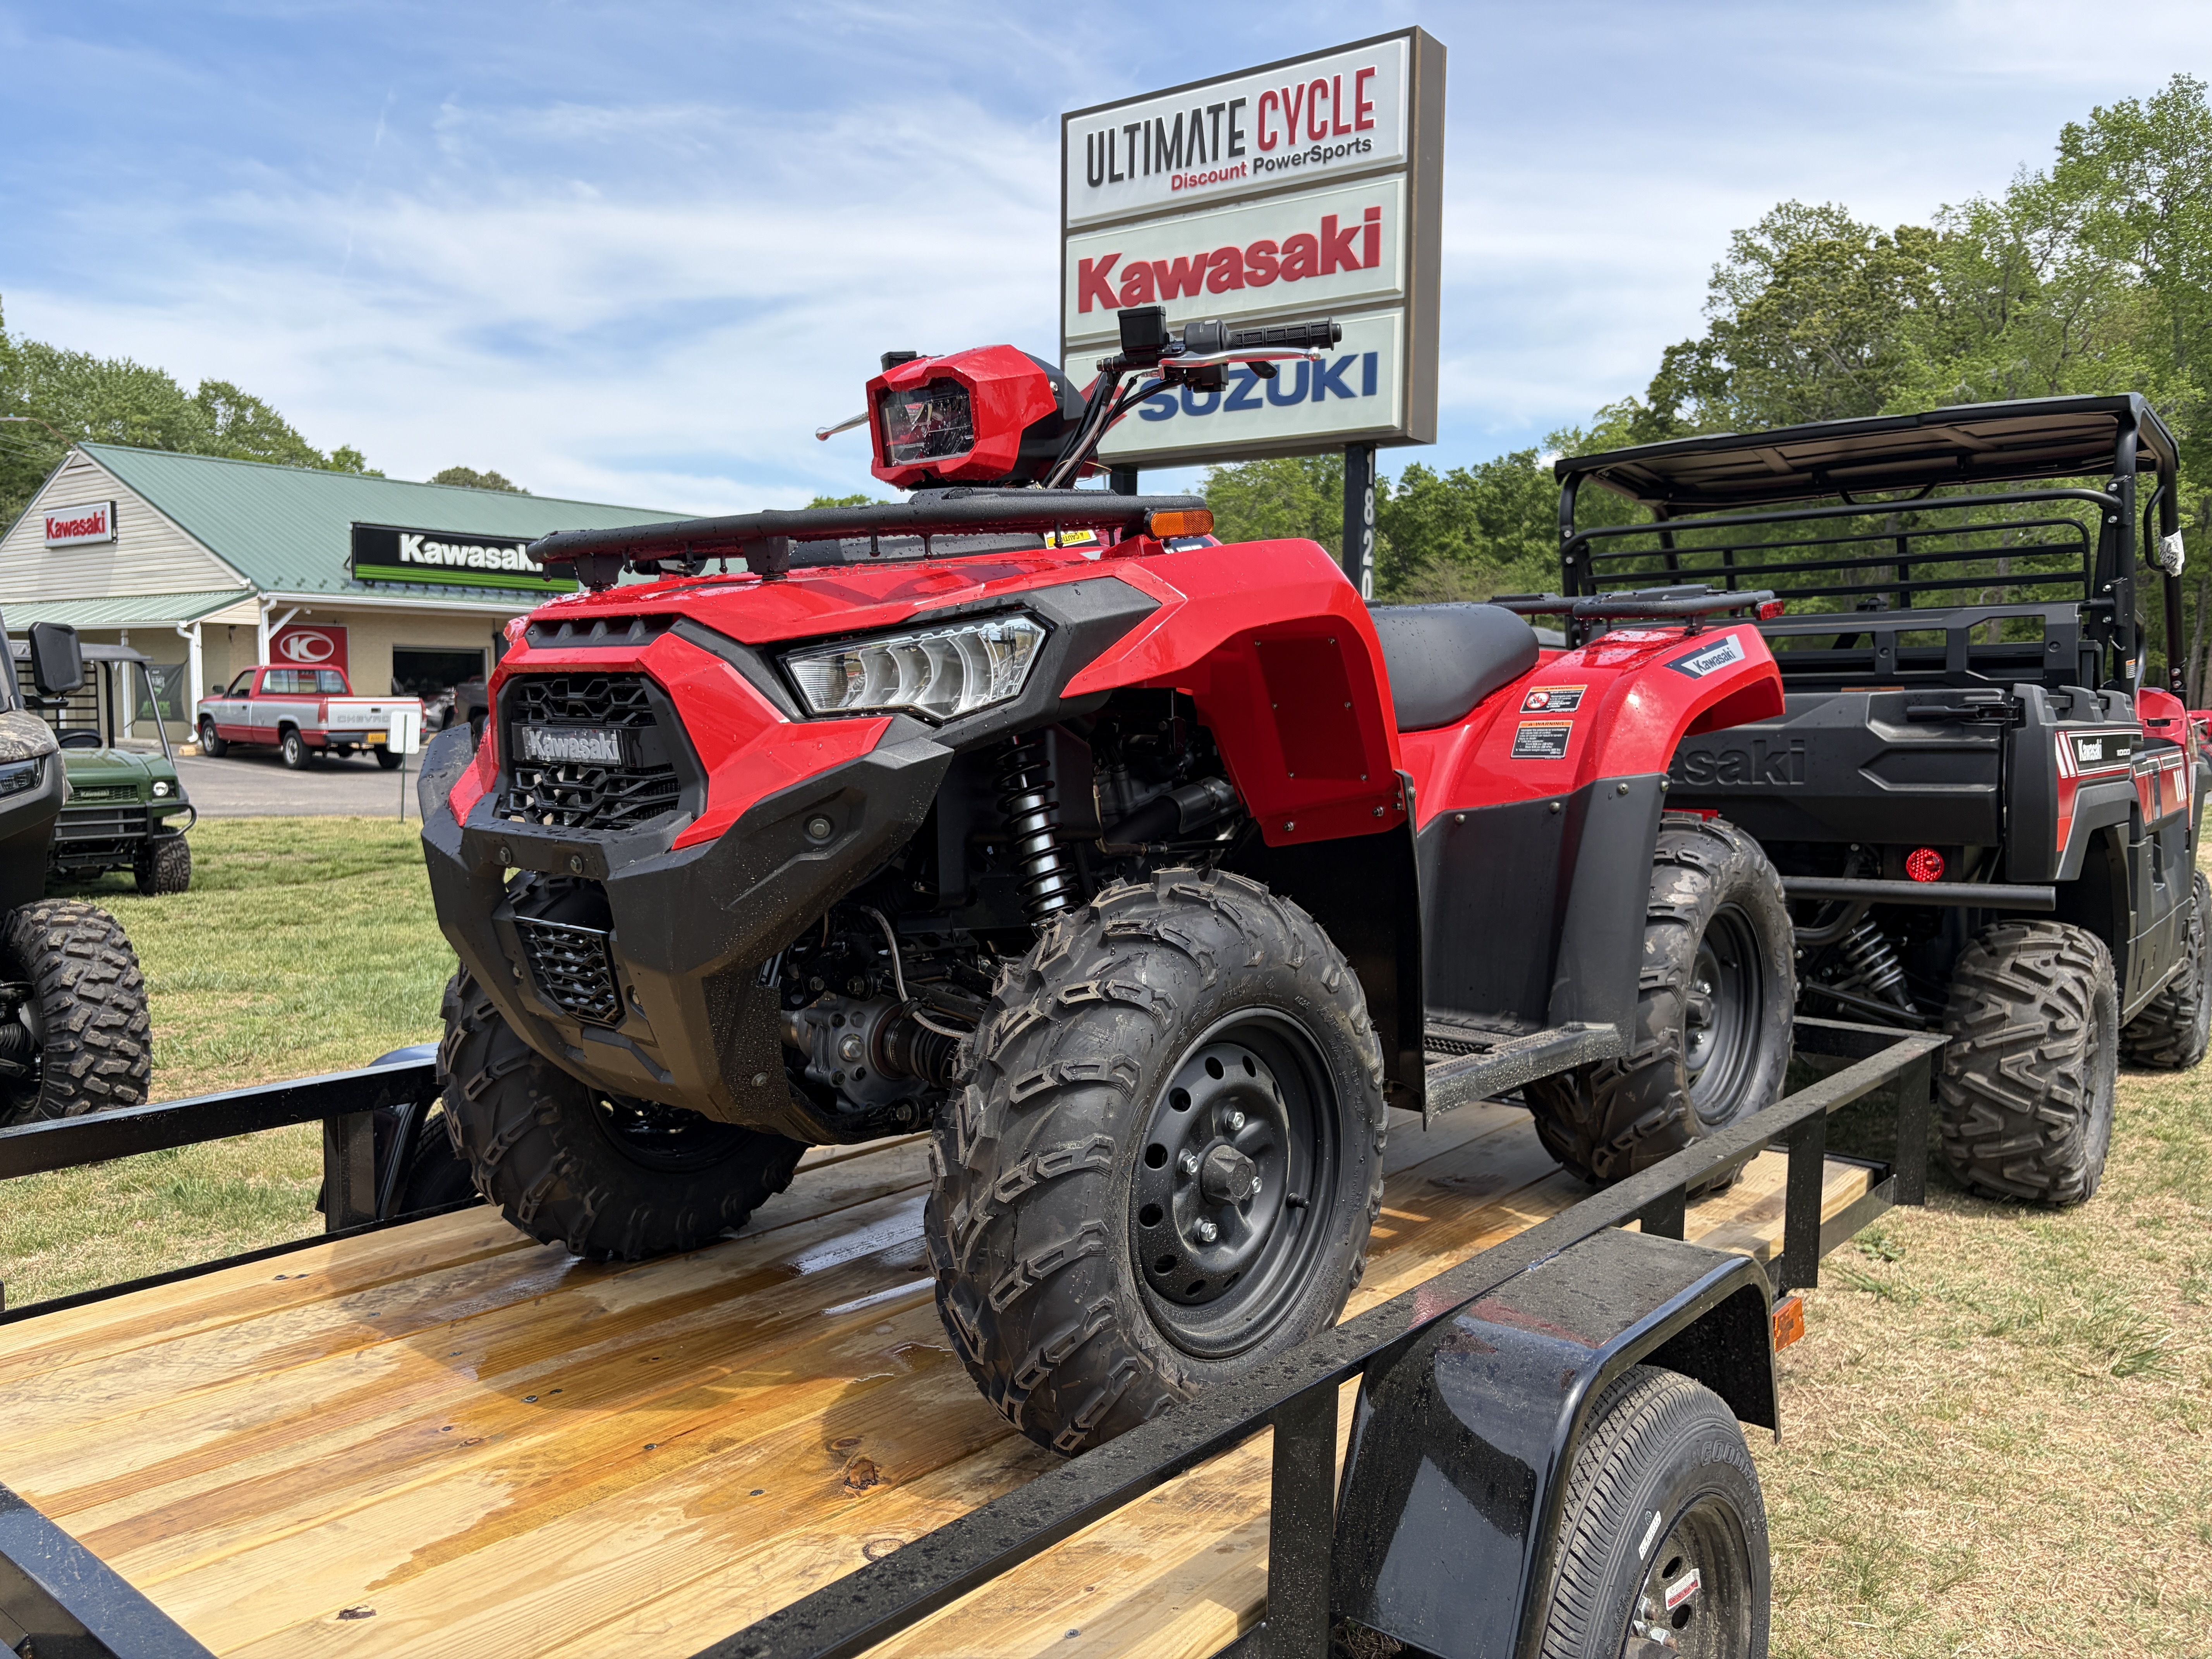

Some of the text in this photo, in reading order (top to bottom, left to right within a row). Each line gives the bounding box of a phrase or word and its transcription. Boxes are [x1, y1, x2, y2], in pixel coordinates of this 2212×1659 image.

[1087, 66, 1376, 187] ULTIMATE CYCLE
[1171, 137, 1372, 191] Discount PowerSports
[1078, 206, 1381, 313] Kawasaki
[1138, 351, 1378, 421] SUZUKI
[46, 510, 106, 540] Kawasaki
[399, 533, 543, 572] Kawasak
[1693, 647, 1736, 673] Kawasaki
[337, 715, 391, 723] CHEVRO
[529, 729, 620, 760] Kawasaki
[2078, 738, 2102, 762] Kawasaki
[1324, 1276, 1345, 1312] WARNING
